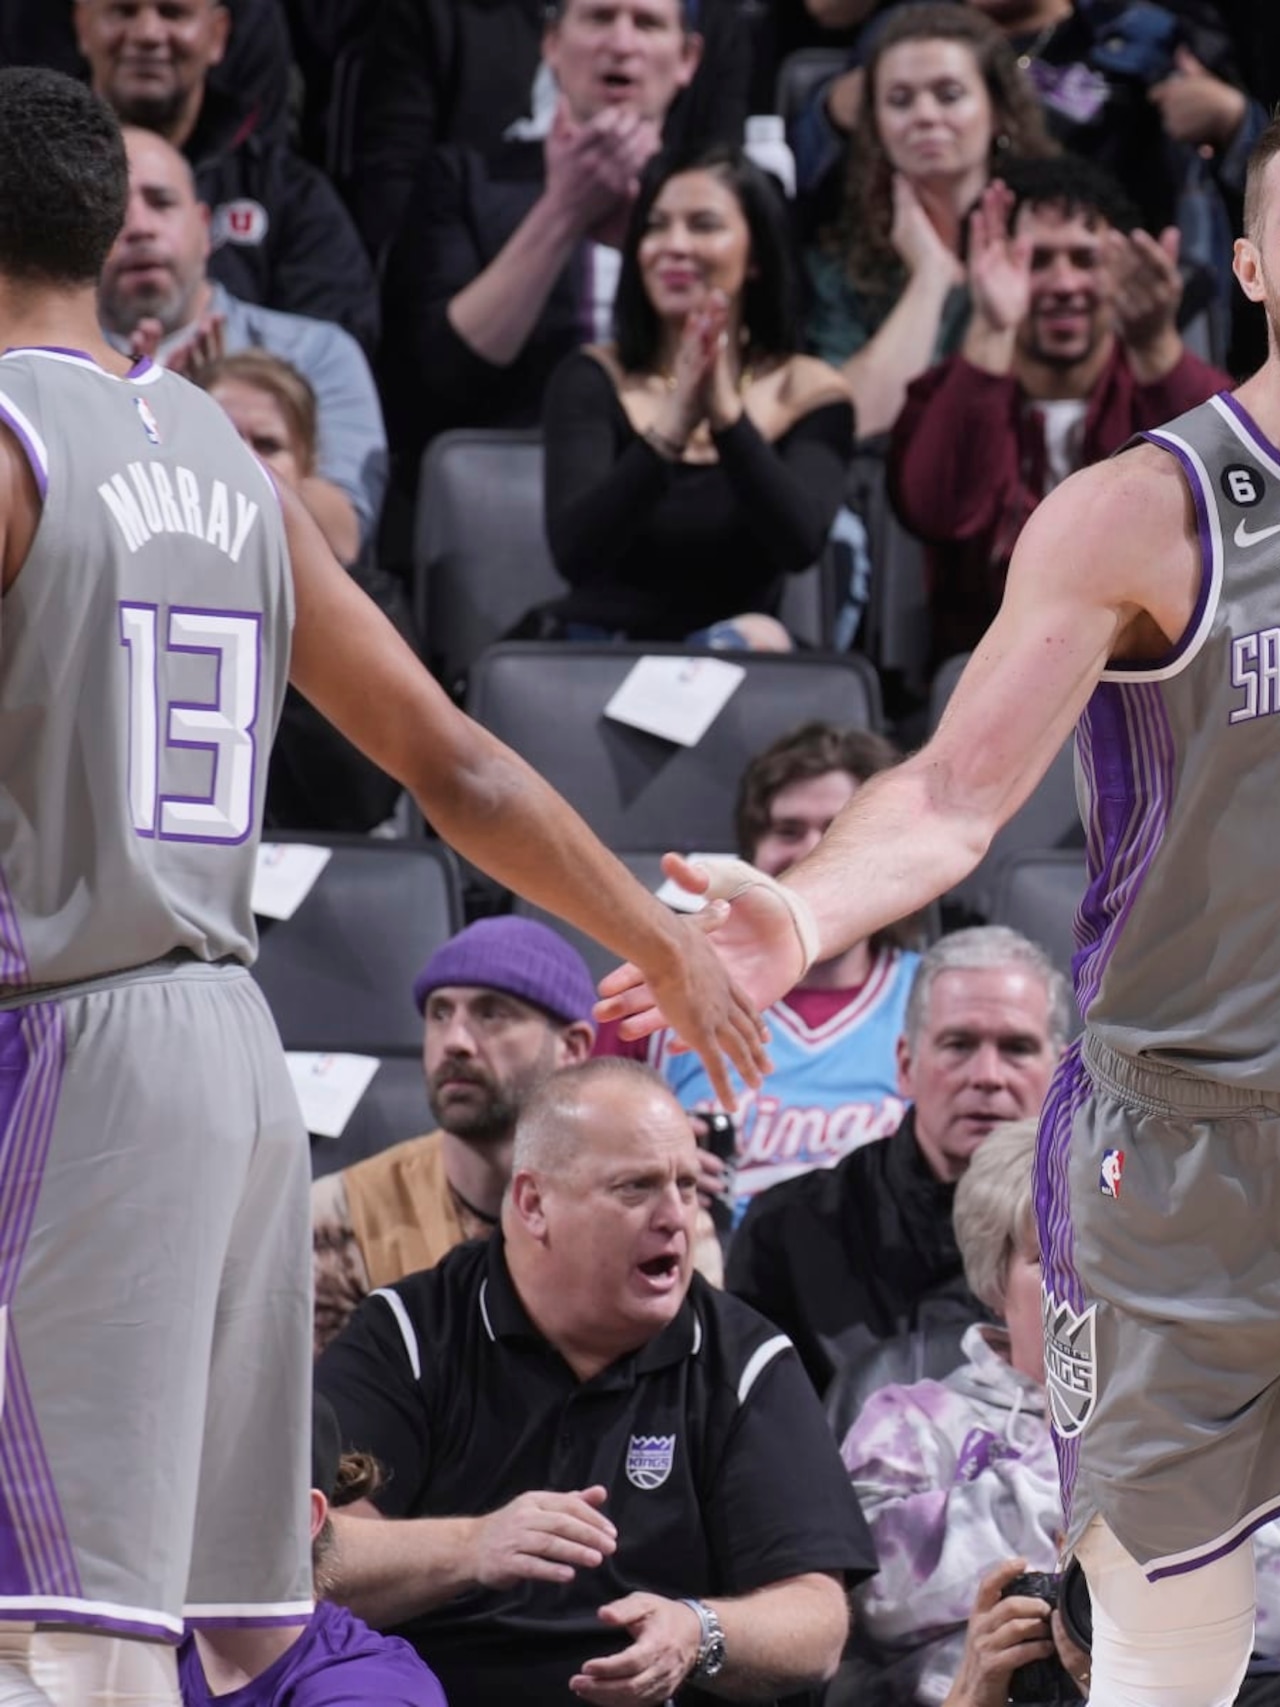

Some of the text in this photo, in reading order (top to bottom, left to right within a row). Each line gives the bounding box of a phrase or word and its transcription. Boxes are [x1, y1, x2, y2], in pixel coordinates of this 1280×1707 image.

[98, 461, 258, 563] MURRAY
[1228, 470, 1256, 503] 6
[118, 600, 262, 846] 13
